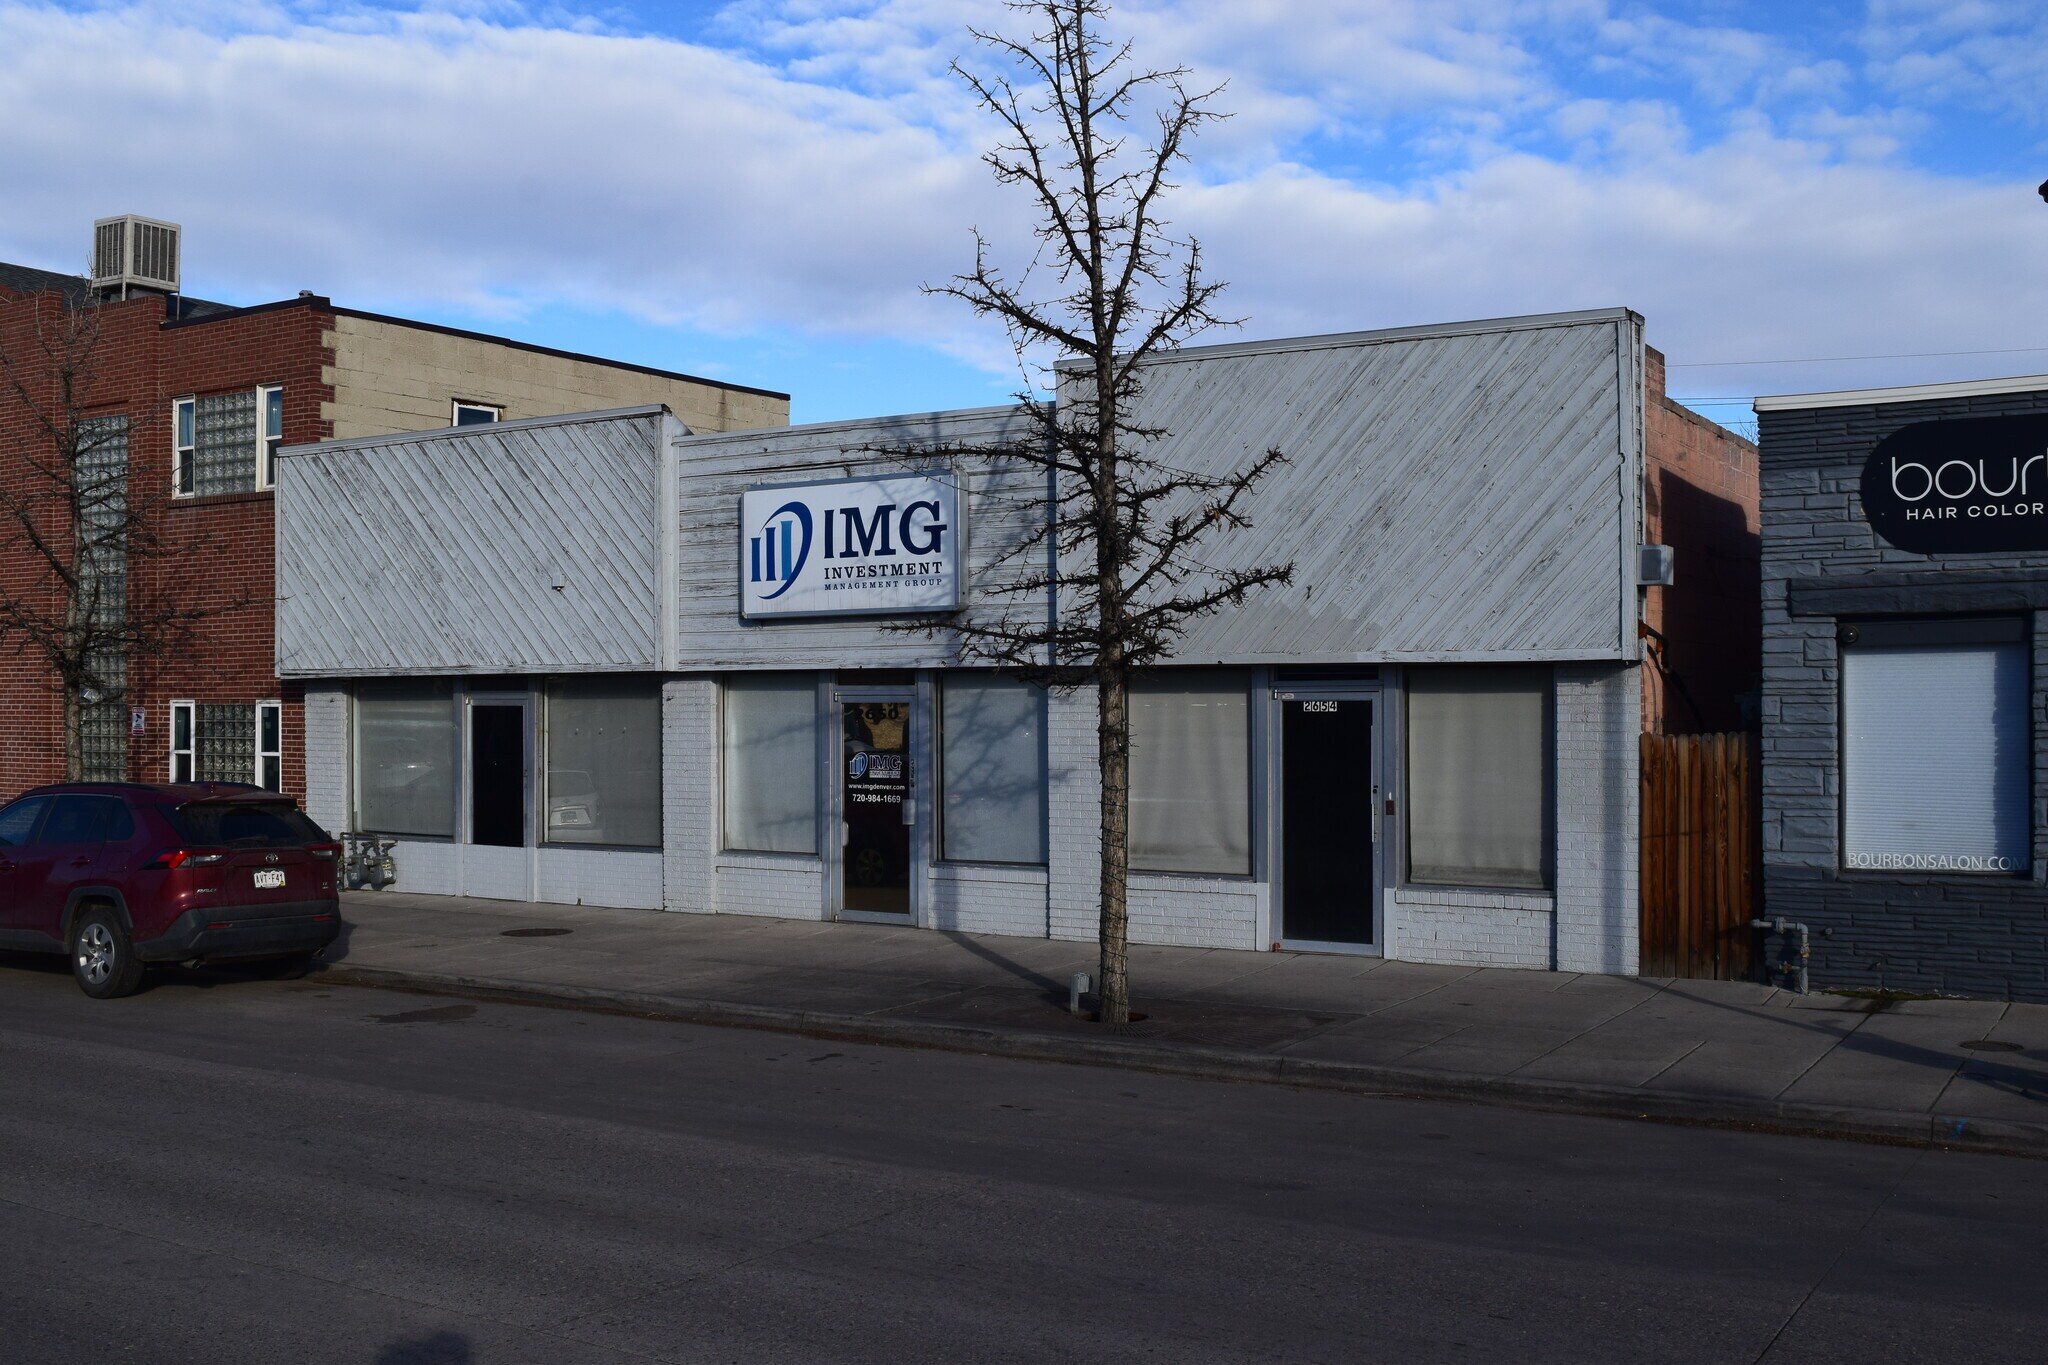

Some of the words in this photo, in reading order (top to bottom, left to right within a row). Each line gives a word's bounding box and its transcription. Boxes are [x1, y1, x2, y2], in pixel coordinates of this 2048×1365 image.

[1891, 447, 2048, 502] bour
[1906, 507, 1957, 521] HAIR
[1967, 502, 2044, 518] COLOR
[824, 500, 947, 559] IMG
[824, 561, 943, 580] INVESTMENT
[824, 580, 899, 591] MANAGEMENT
[904, 578, 943, 587] GROUP
[1304, 701, 1337, 711] 2654
[868, 754, 903, 771] IMG
[852, 794, 901, 803] 720-984-1669
